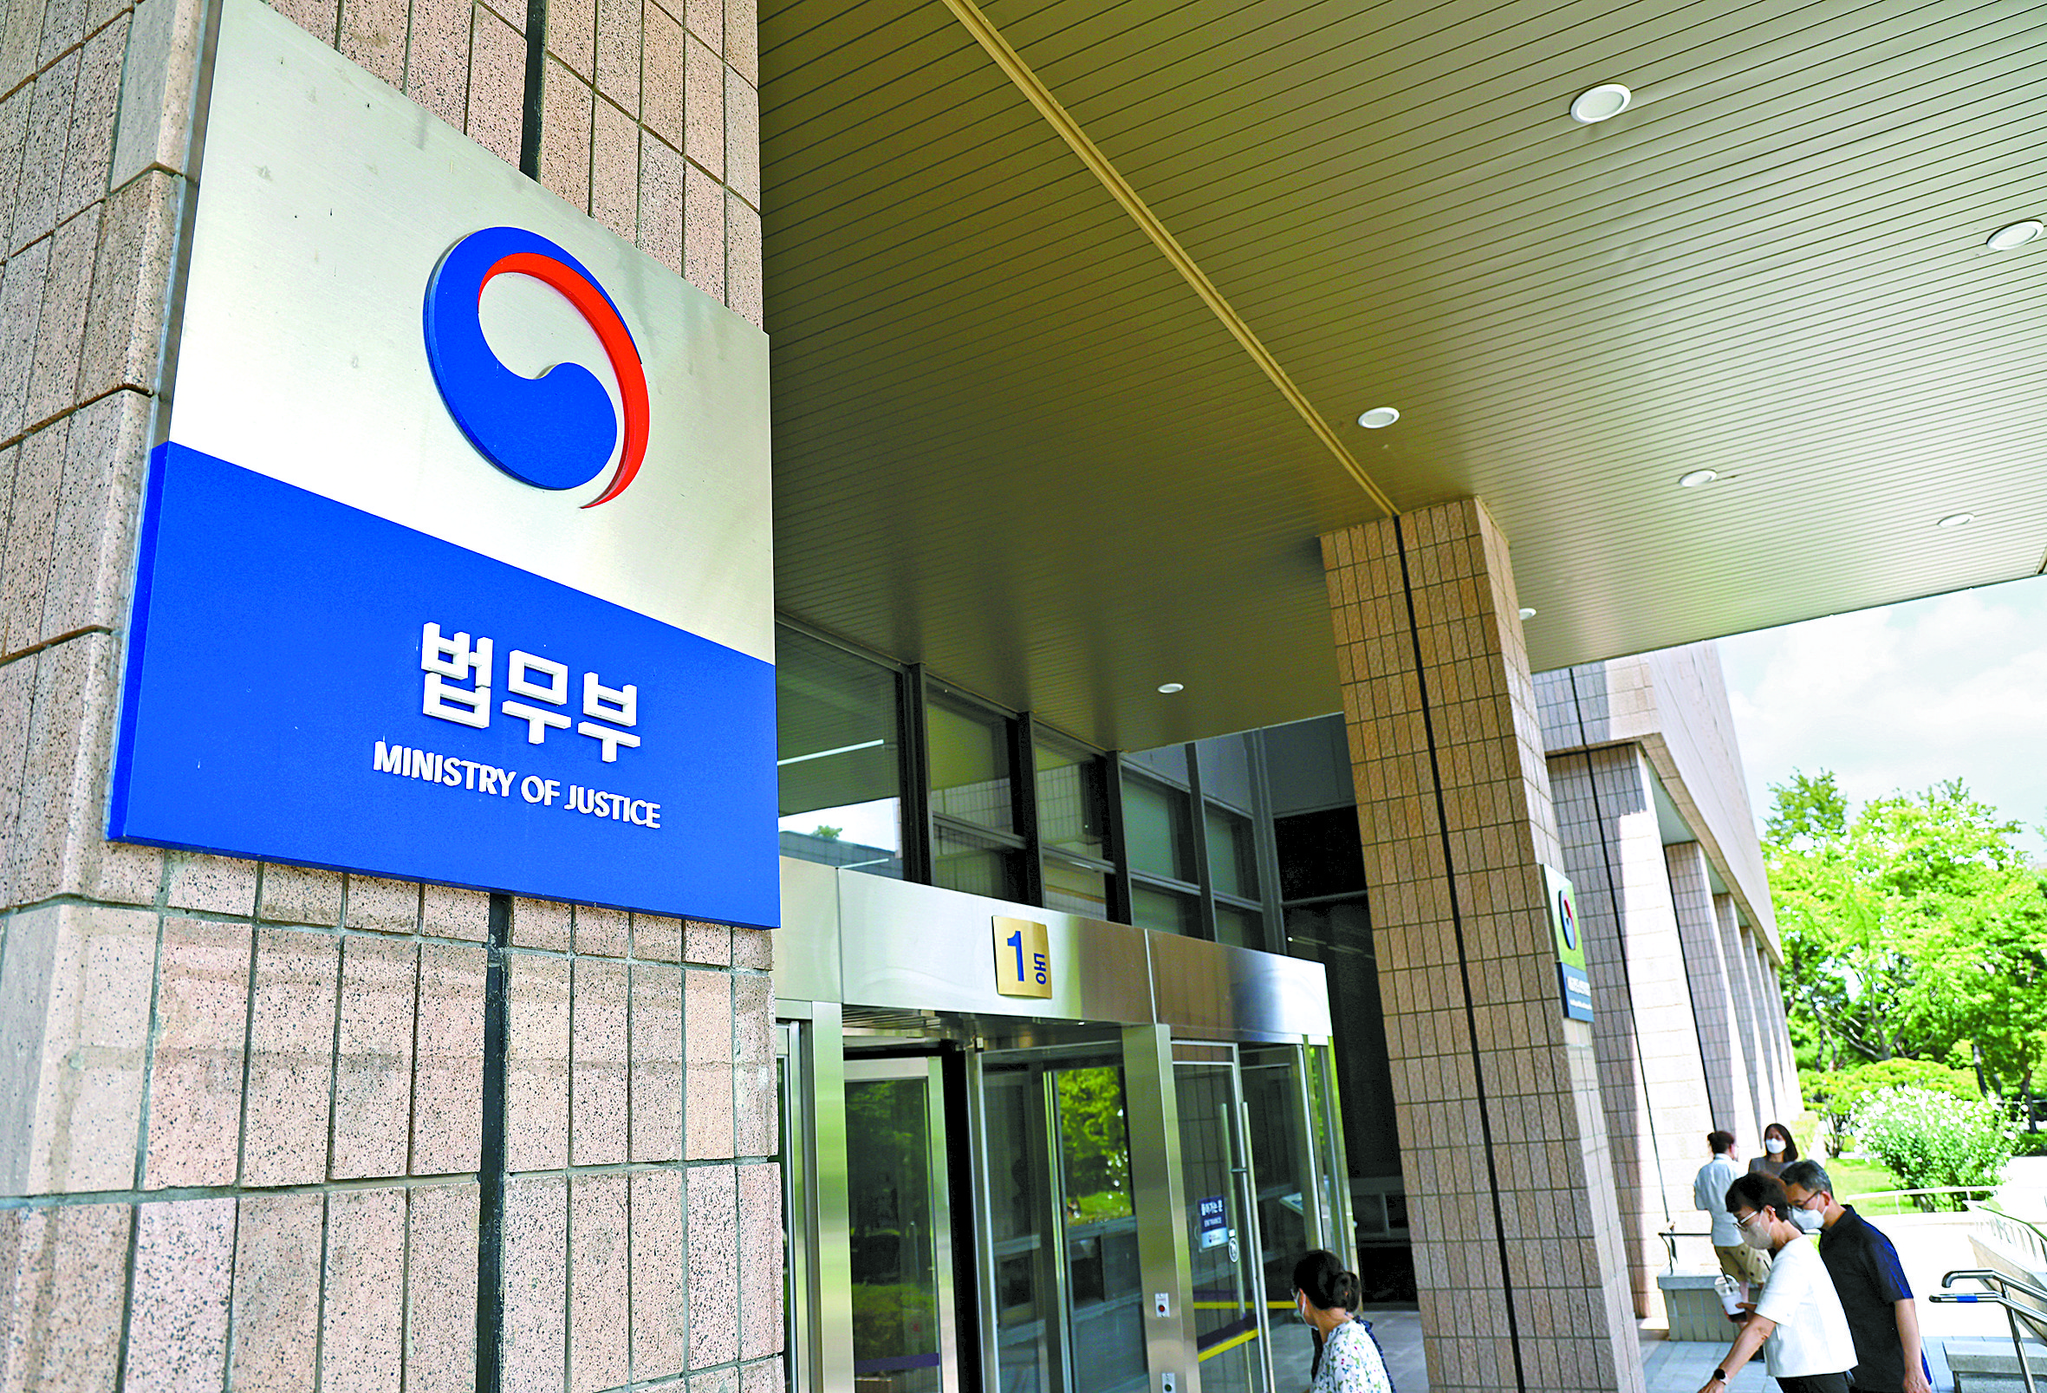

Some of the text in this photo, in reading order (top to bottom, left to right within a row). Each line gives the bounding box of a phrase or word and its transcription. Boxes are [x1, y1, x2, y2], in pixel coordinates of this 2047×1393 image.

[421, 622, 641, 763] 법무부
[373, 740, 661, 829] MINISTRY OF JUSTICE
